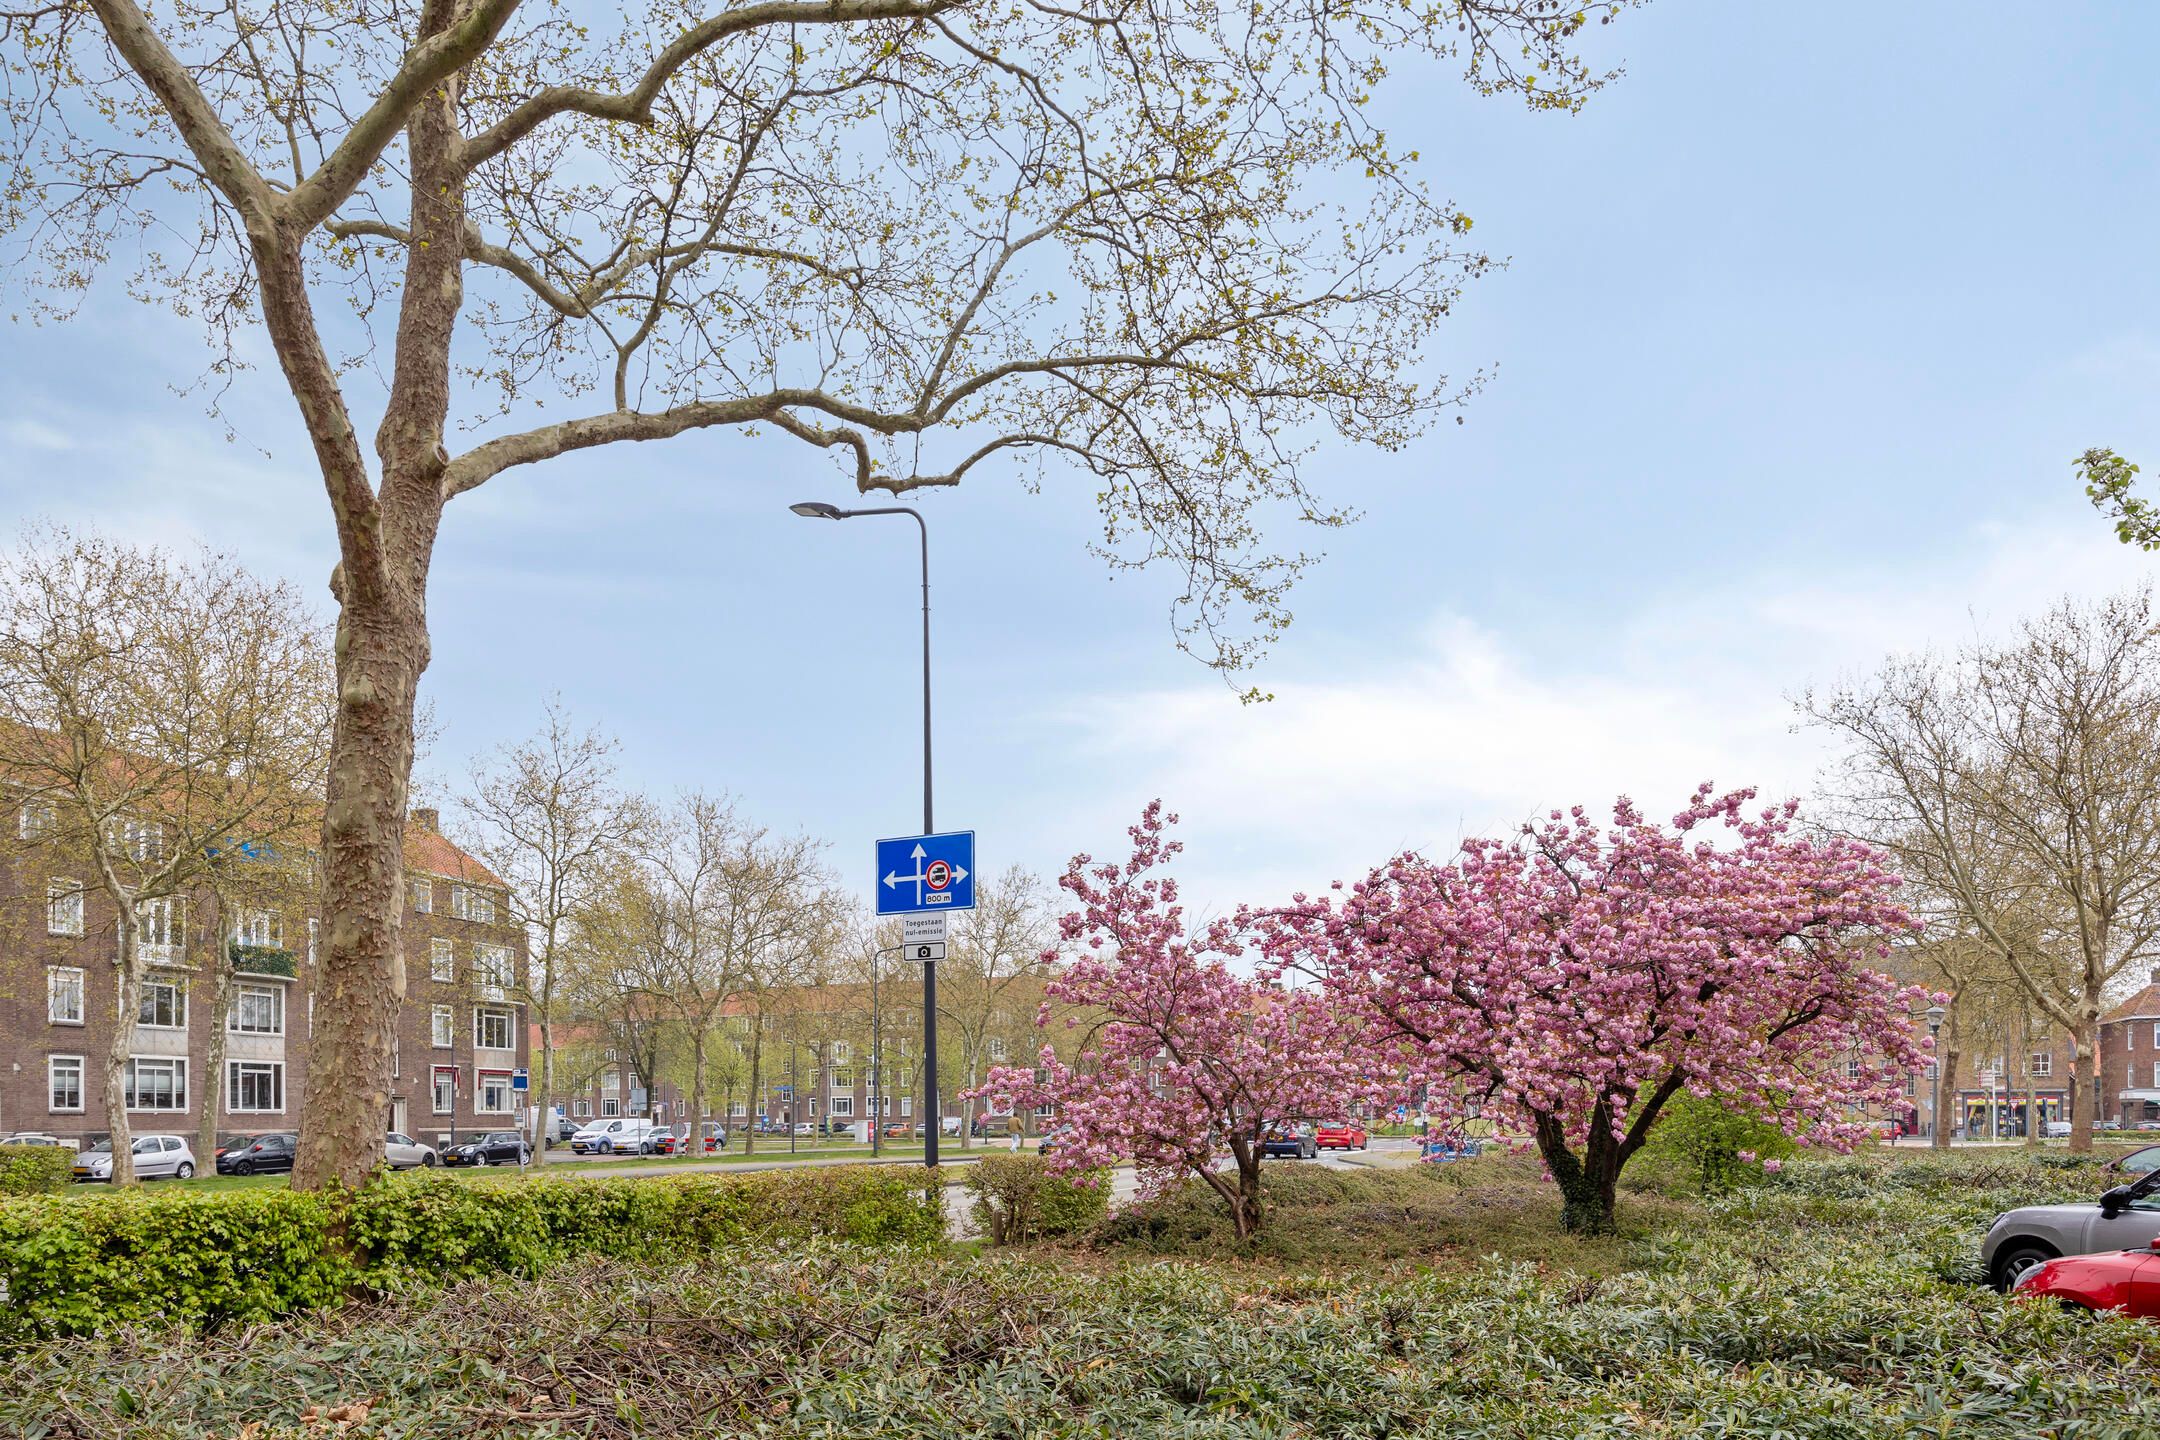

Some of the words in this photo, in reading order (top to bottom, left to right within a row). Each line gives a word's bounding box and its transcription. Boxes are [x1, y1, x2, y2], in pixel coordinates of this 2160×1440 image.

[927, 895, 942, 903] 800
[905, 919, 942, 927] Toegestaan
[905, 928, 942, 936] nul-emissie
